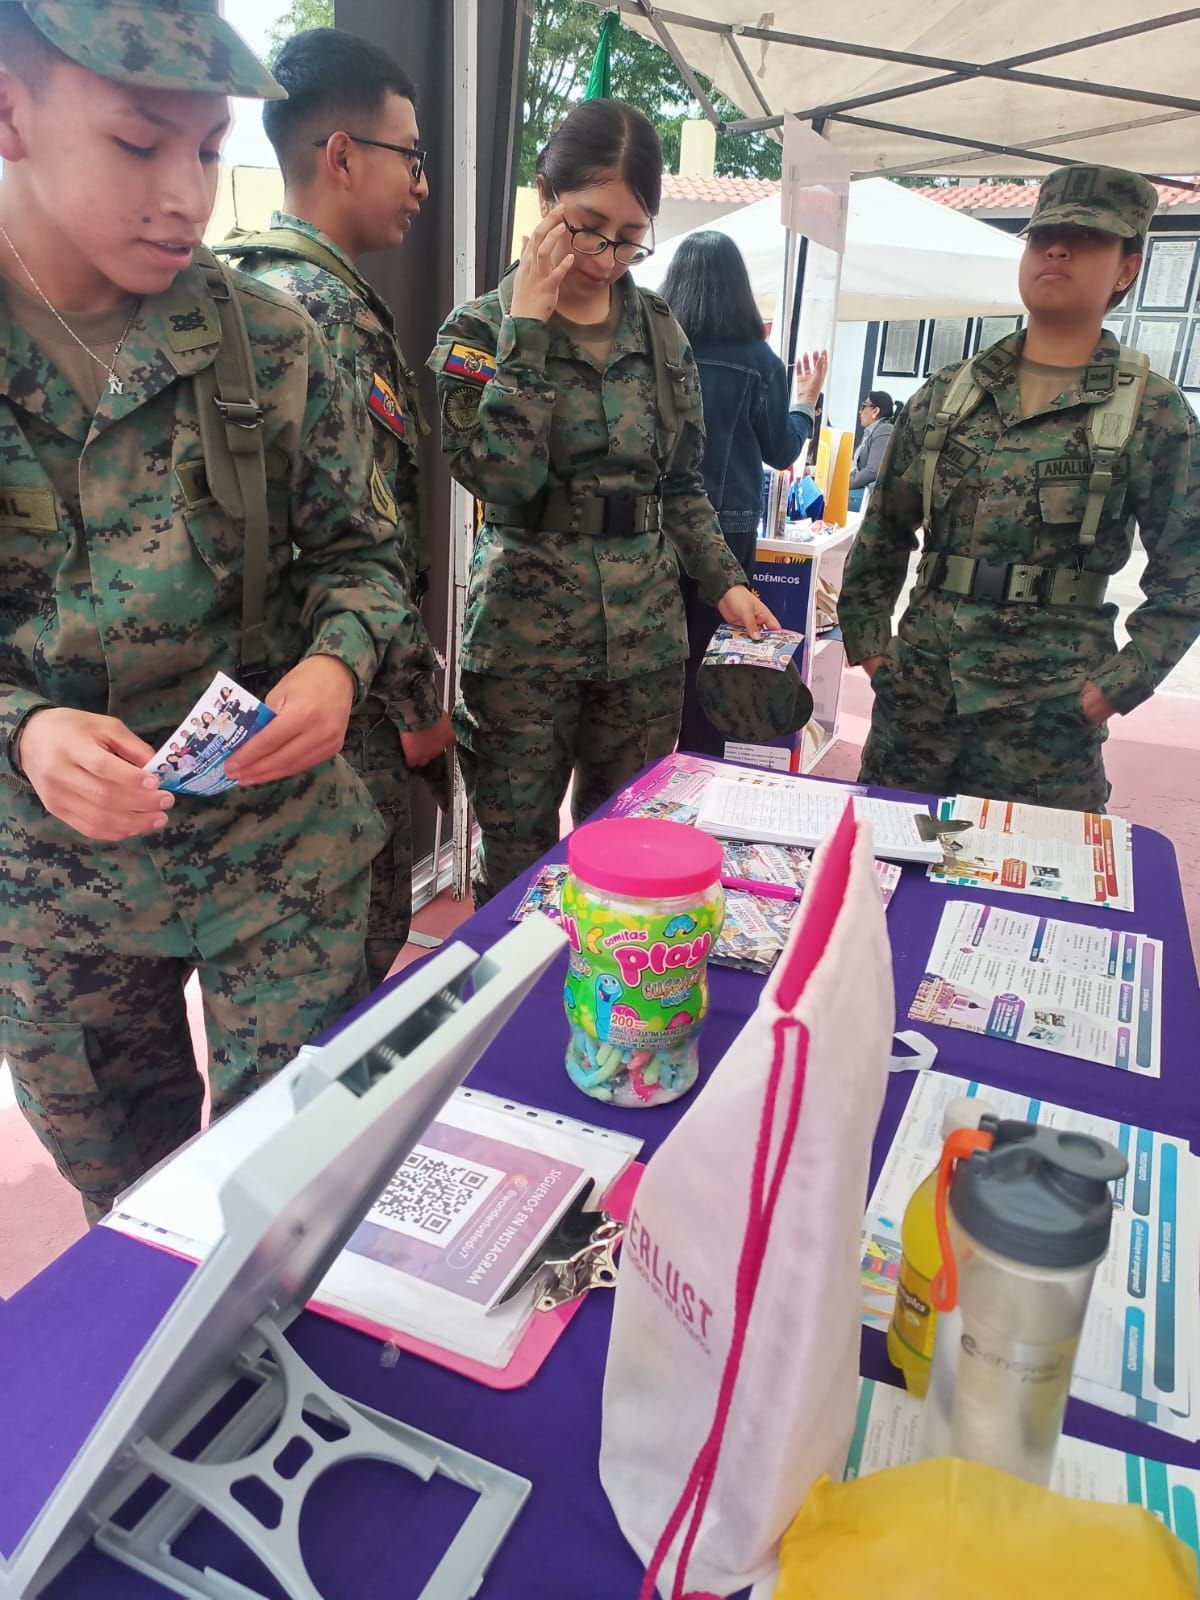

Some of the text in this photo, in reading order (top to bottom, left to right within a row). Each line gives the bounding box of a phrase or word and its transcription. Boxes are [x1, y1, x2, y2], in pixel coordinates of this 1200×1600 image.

[1044, 458, 1094, 477] ANALU
[611, 1014, 633, 1027] 200
[522, 1168, 563, 1214] SÍGUENOS
[466, 1226, 518, 1286] INSTAGRAM
